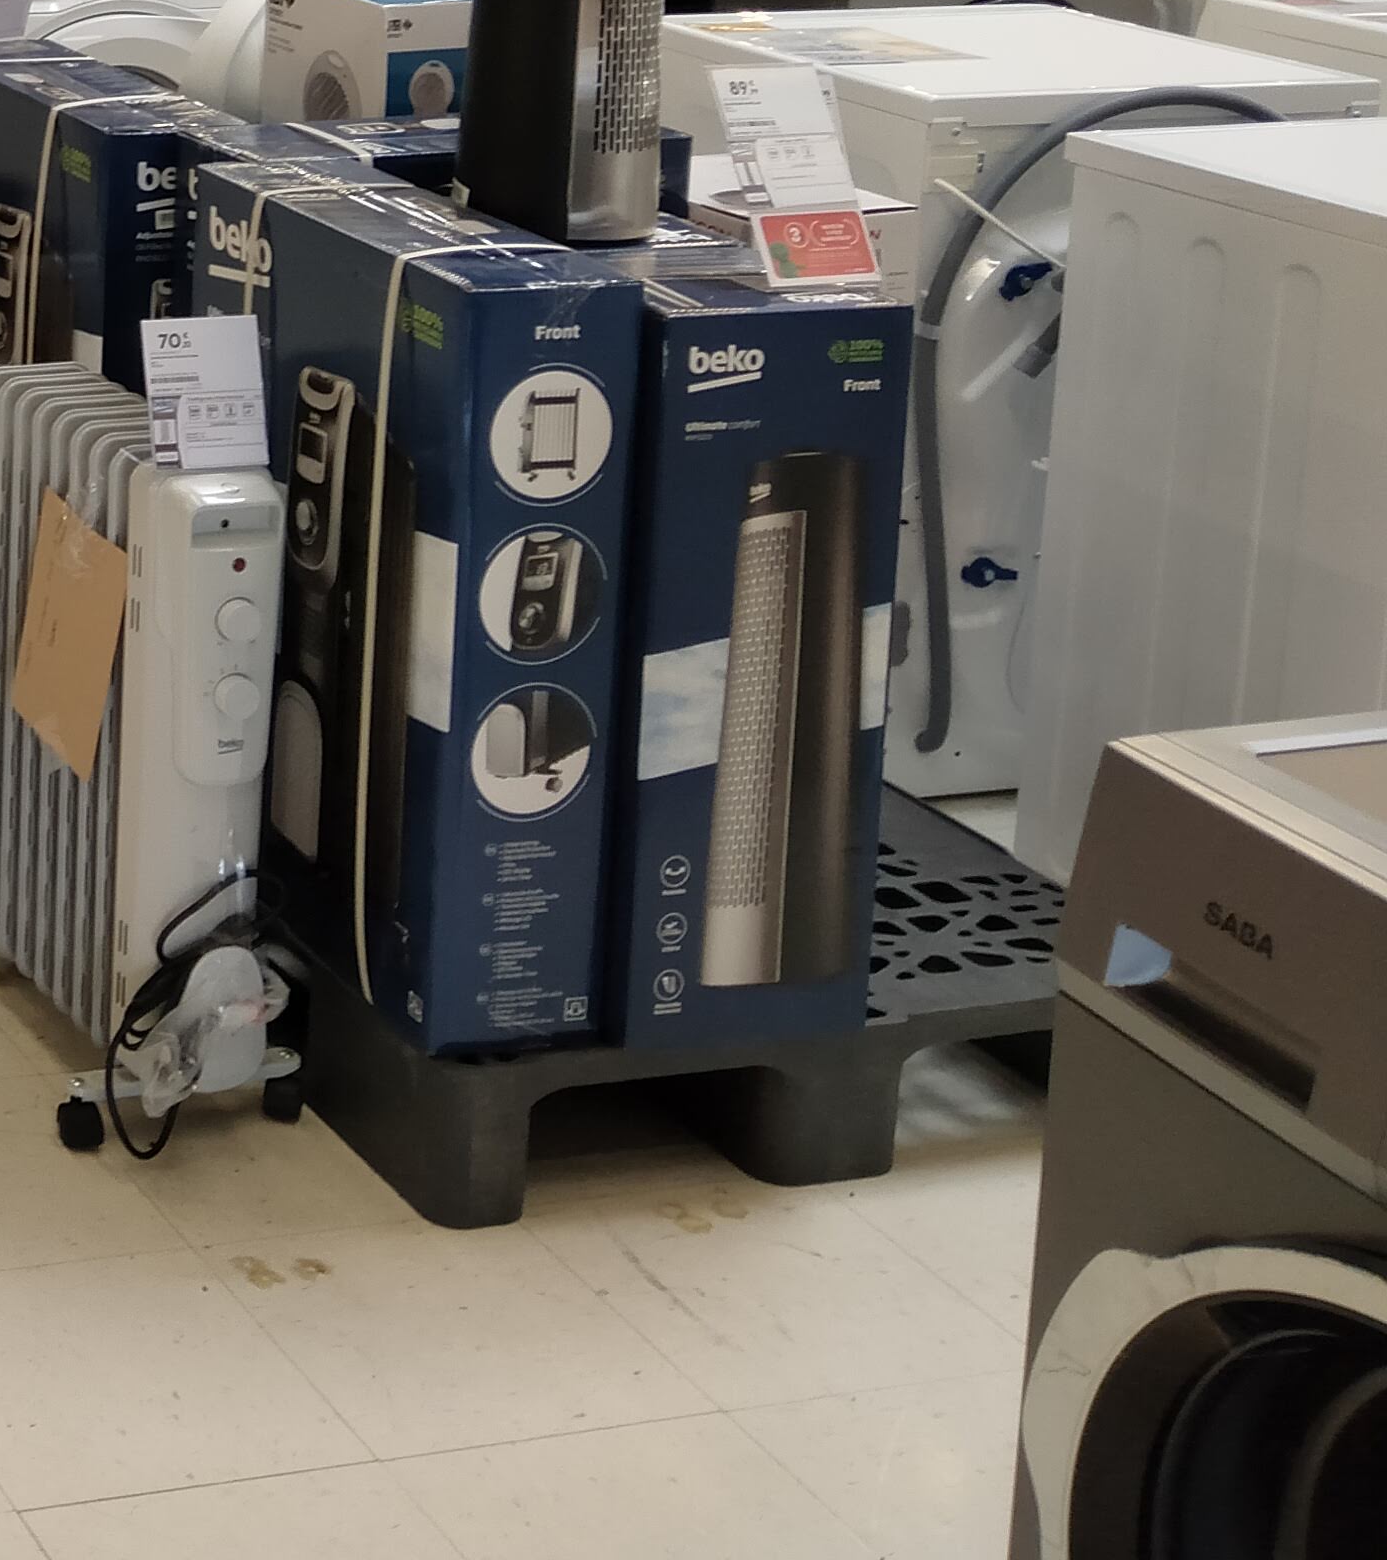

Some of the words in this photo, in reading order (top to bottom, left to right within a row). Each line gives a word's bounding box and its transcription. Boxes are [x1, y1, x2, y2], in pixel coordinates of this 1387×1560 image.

[137, 161, 177, 191] be
[534, 323, 582, 341] Front
[688, 344, 765, 375] beko
[843, 378, 882, 393] Front
[1203, 900, 1274, 960] SABA
